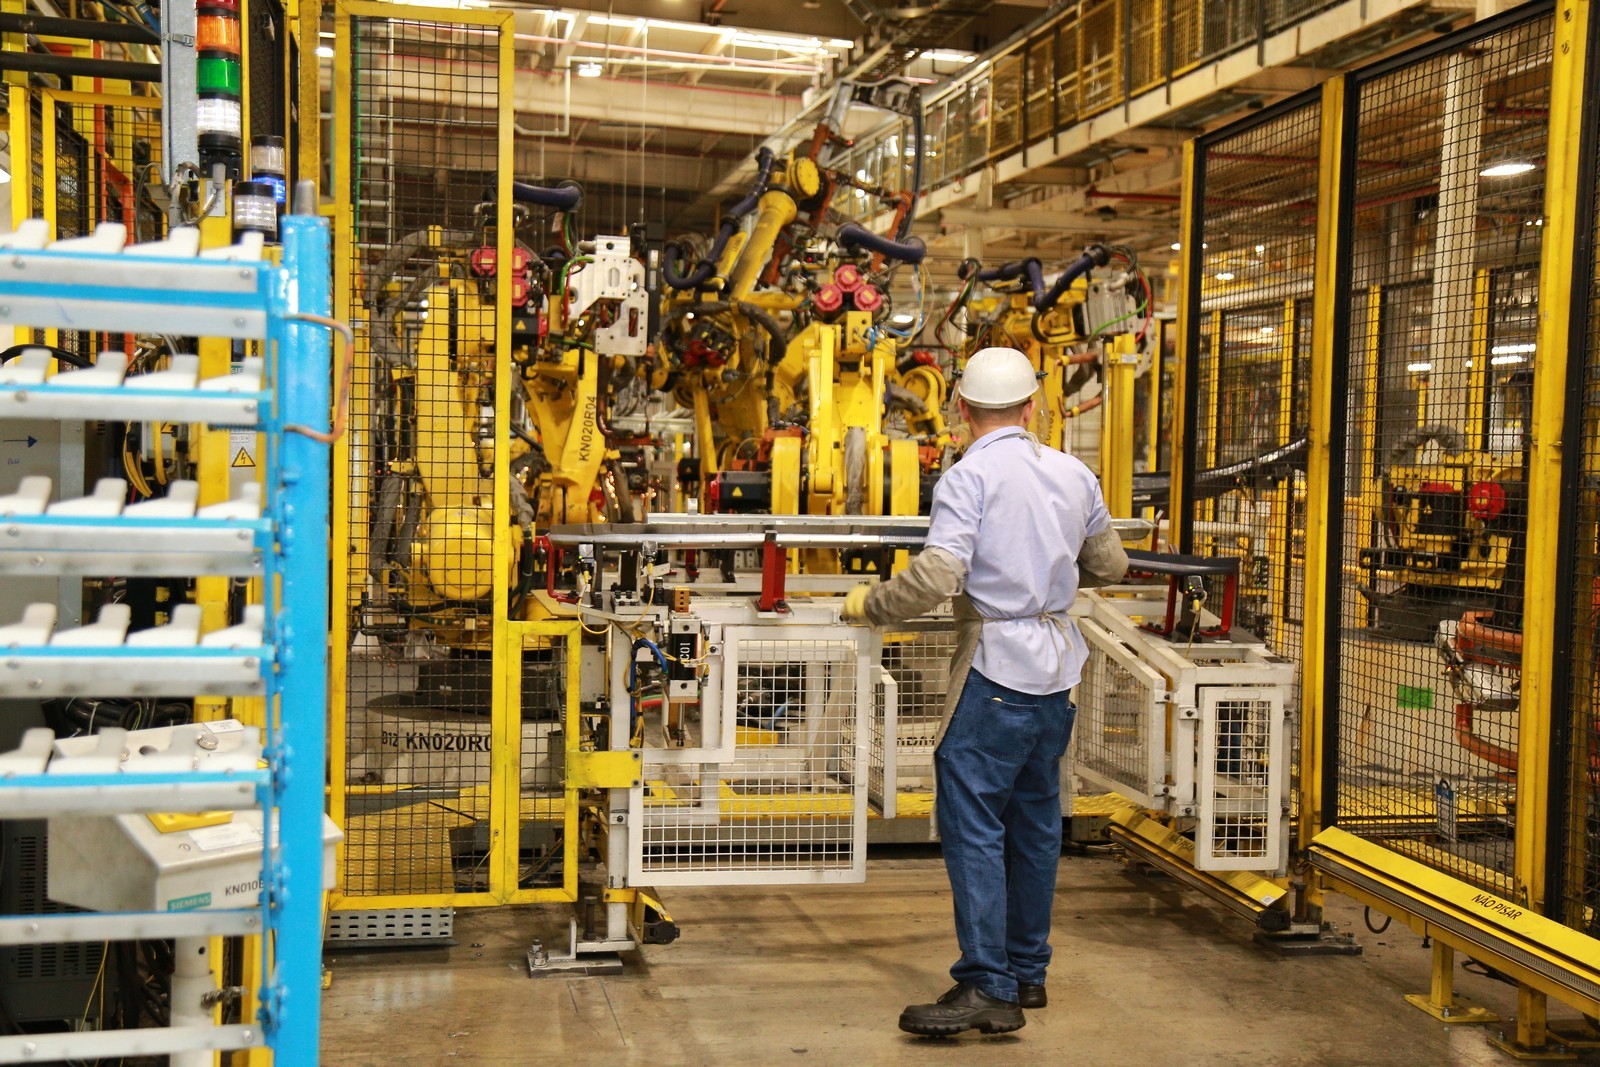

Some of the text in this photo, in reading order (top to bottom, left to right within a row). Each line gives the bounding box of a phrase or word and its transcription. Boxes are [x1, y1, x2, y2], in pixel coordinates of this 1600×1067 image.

[579, 396, 597, 462] KN020R04
[1471, 894, 1522, 920] NÃO PISAR
